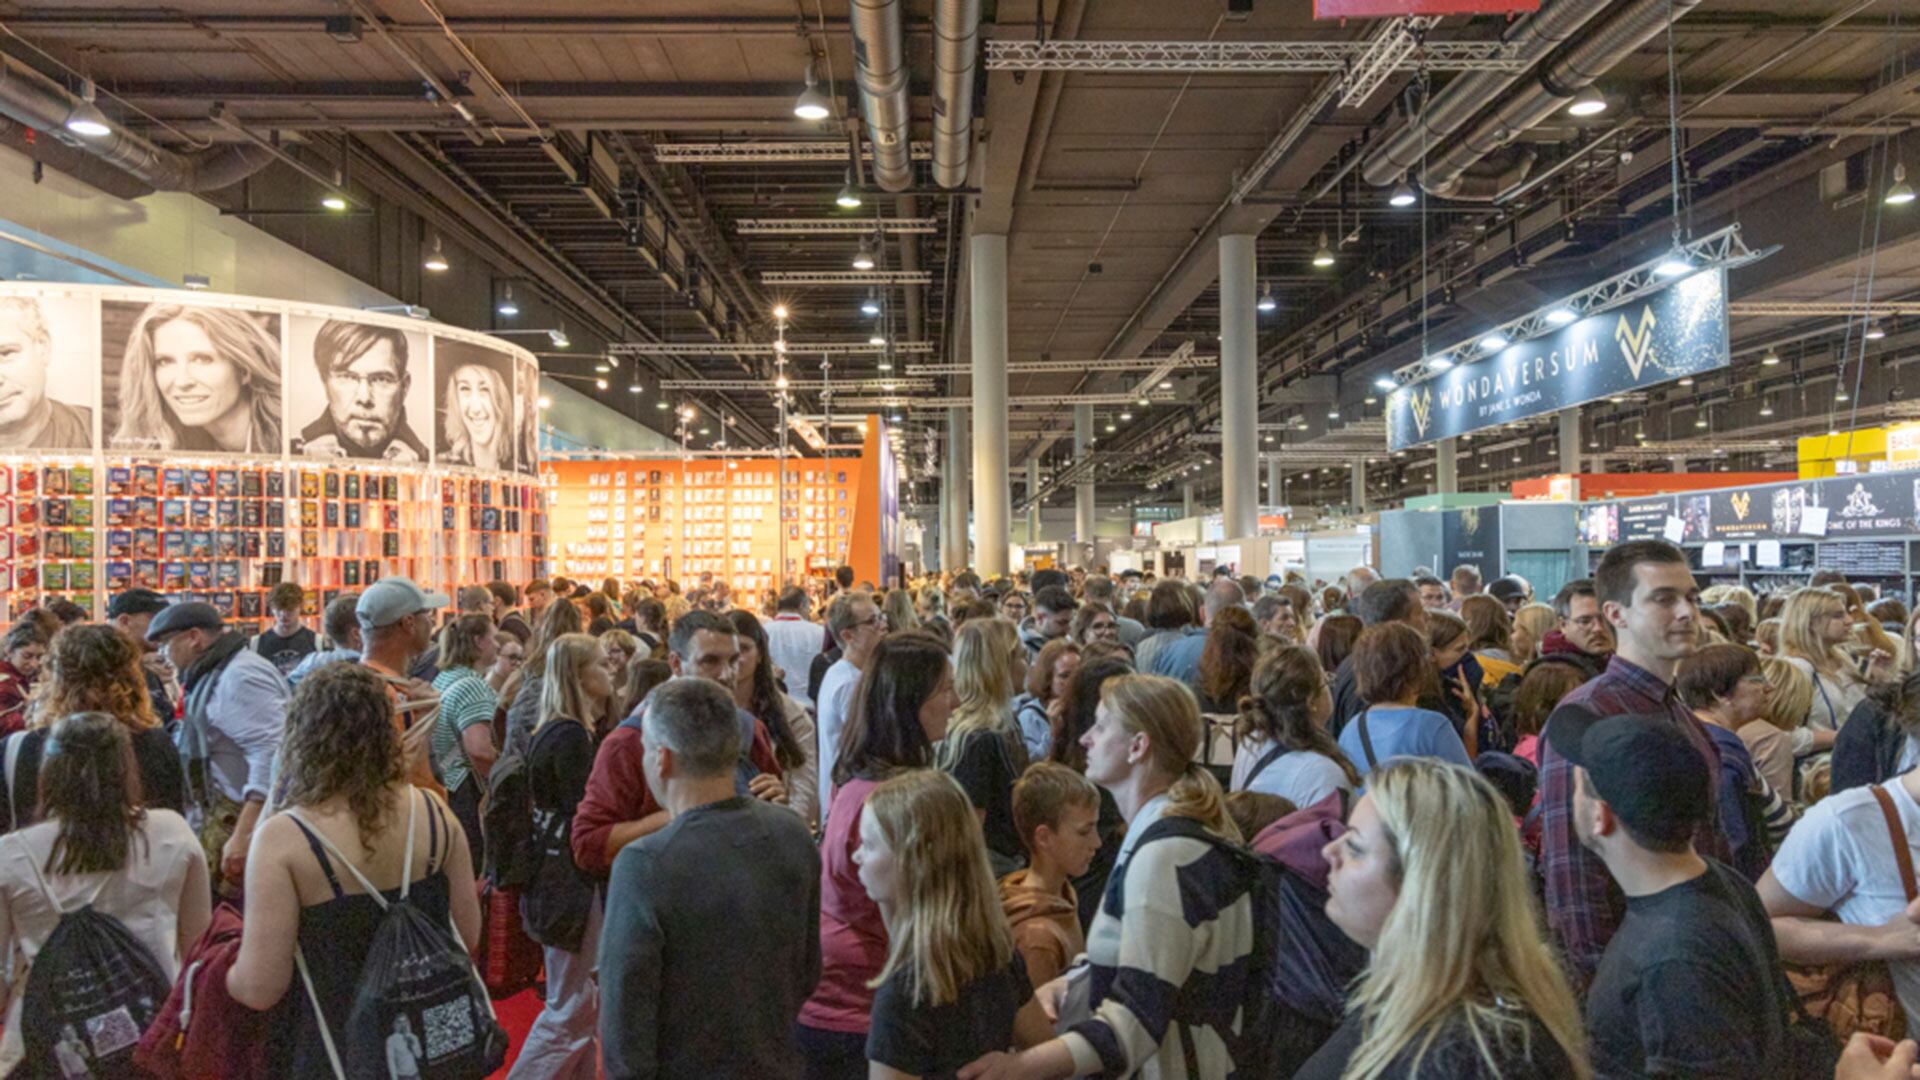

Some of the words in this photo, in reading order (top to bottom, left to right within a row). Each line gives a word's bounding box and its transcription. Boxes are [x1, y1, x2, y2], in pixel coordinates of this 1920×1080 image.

[1439, 339, 1599, 409] WONDAVERSUM
[1513, 390, 1542, 407] WONDA
[1846, 521, 1857, 530] OF
[1860, 520, 1873, 530] THE
[1875, 518, 1901, 528] KINGS
